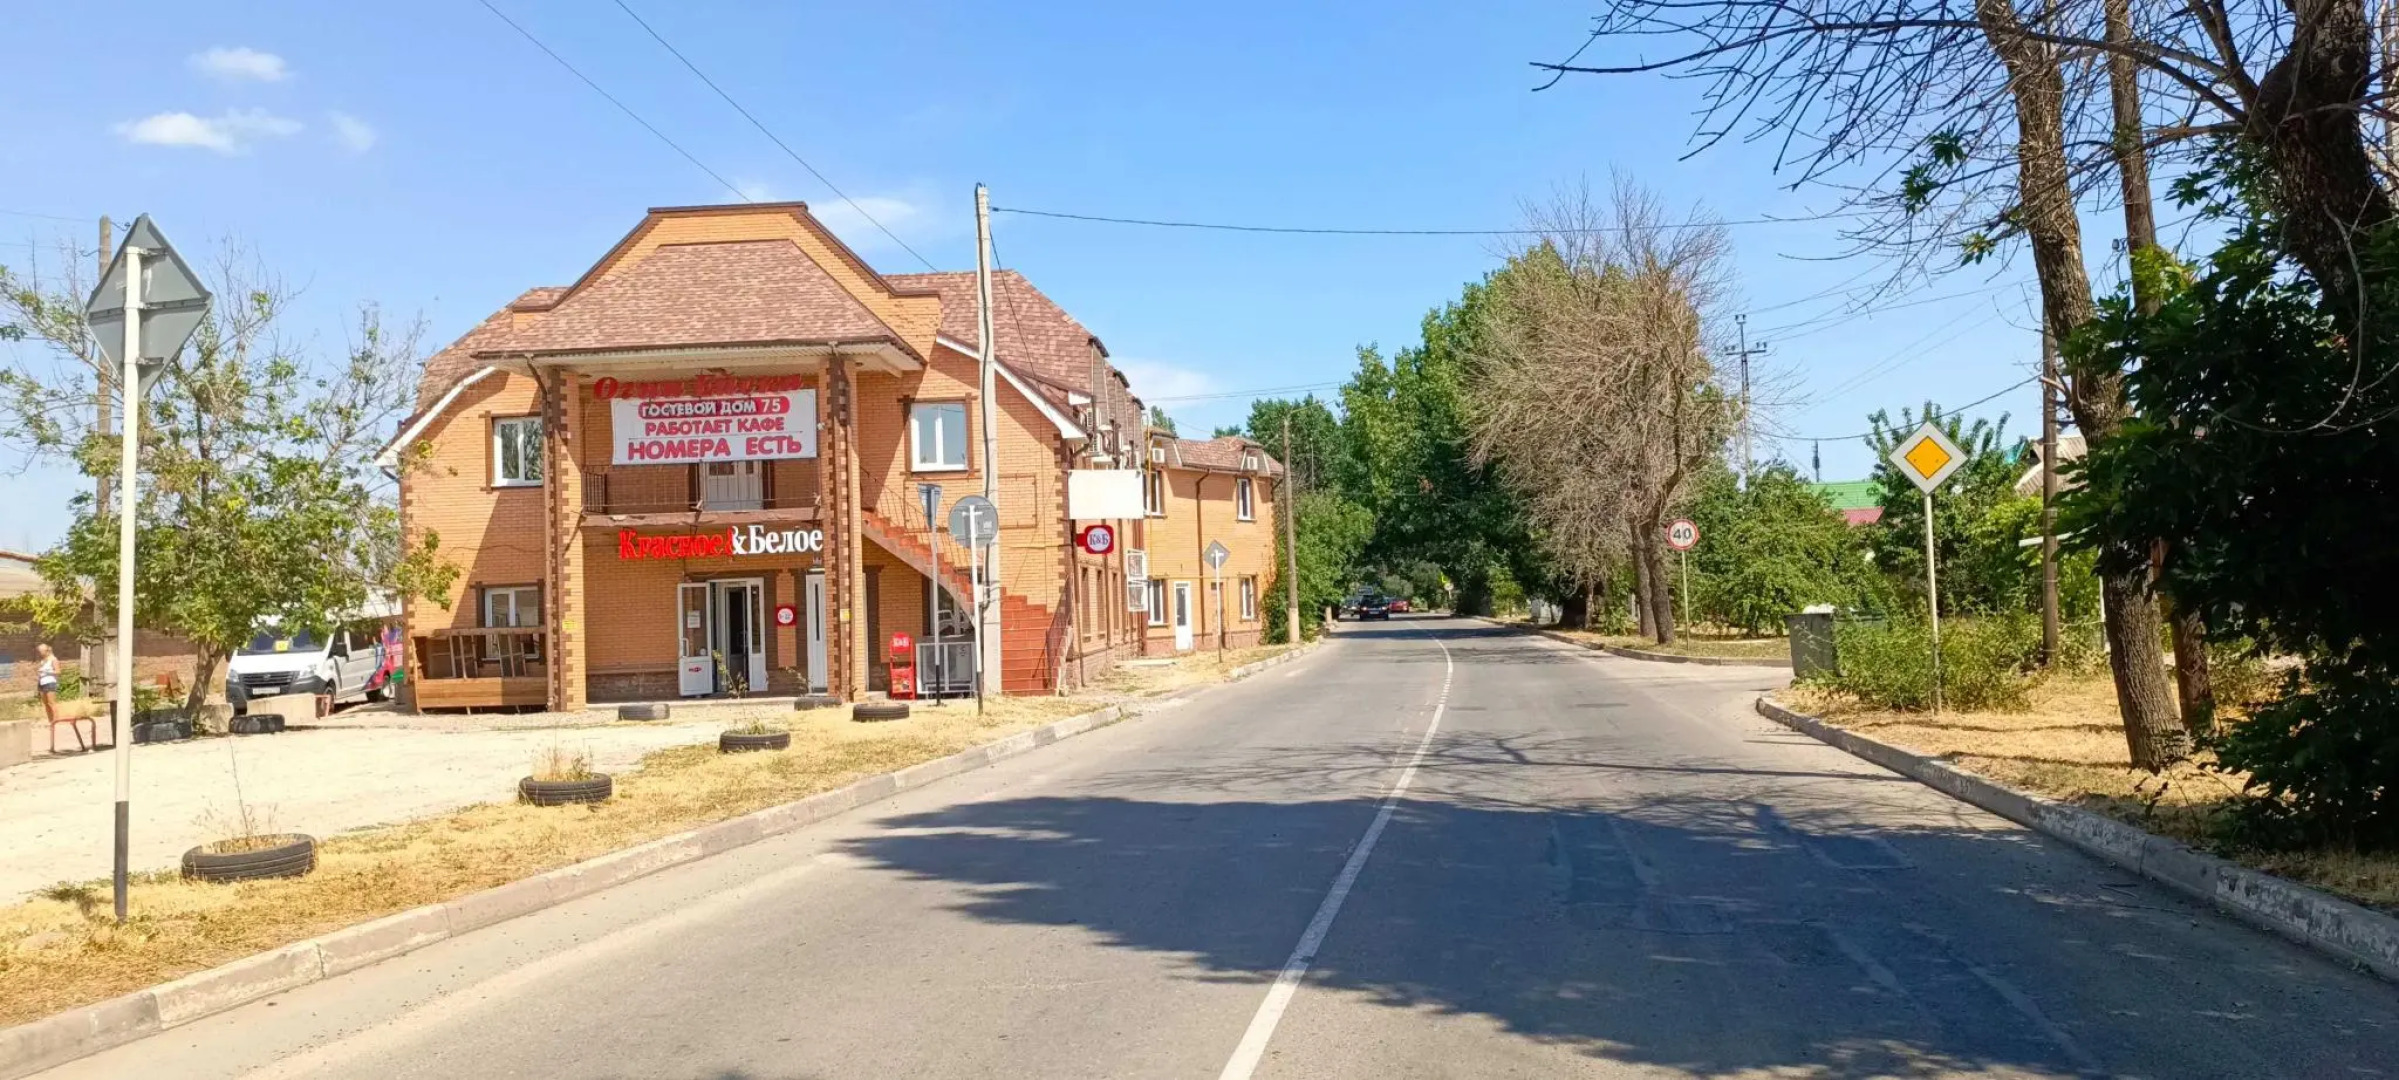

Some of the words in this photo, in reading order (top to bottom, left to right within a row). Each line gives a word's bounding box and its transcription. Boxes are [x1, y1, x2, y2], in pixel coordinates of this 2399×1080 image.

[642, 401, 716, 418] ГОСТЕВОЙ
[720, 400, 756, 416] ДОМ
[761, 399, 781, 413] 75
[645, 419, 732, 436] РАБОТАЕТ
[737, 417, 784, 432] КАФЕ
[628, 437, 731, 460] НОМЕРА
[745, 435, 802, 455] ЕСТЬ
[1090, 534, 1109, 546] К&Б
[1673, 528, 1692, 540] 40
